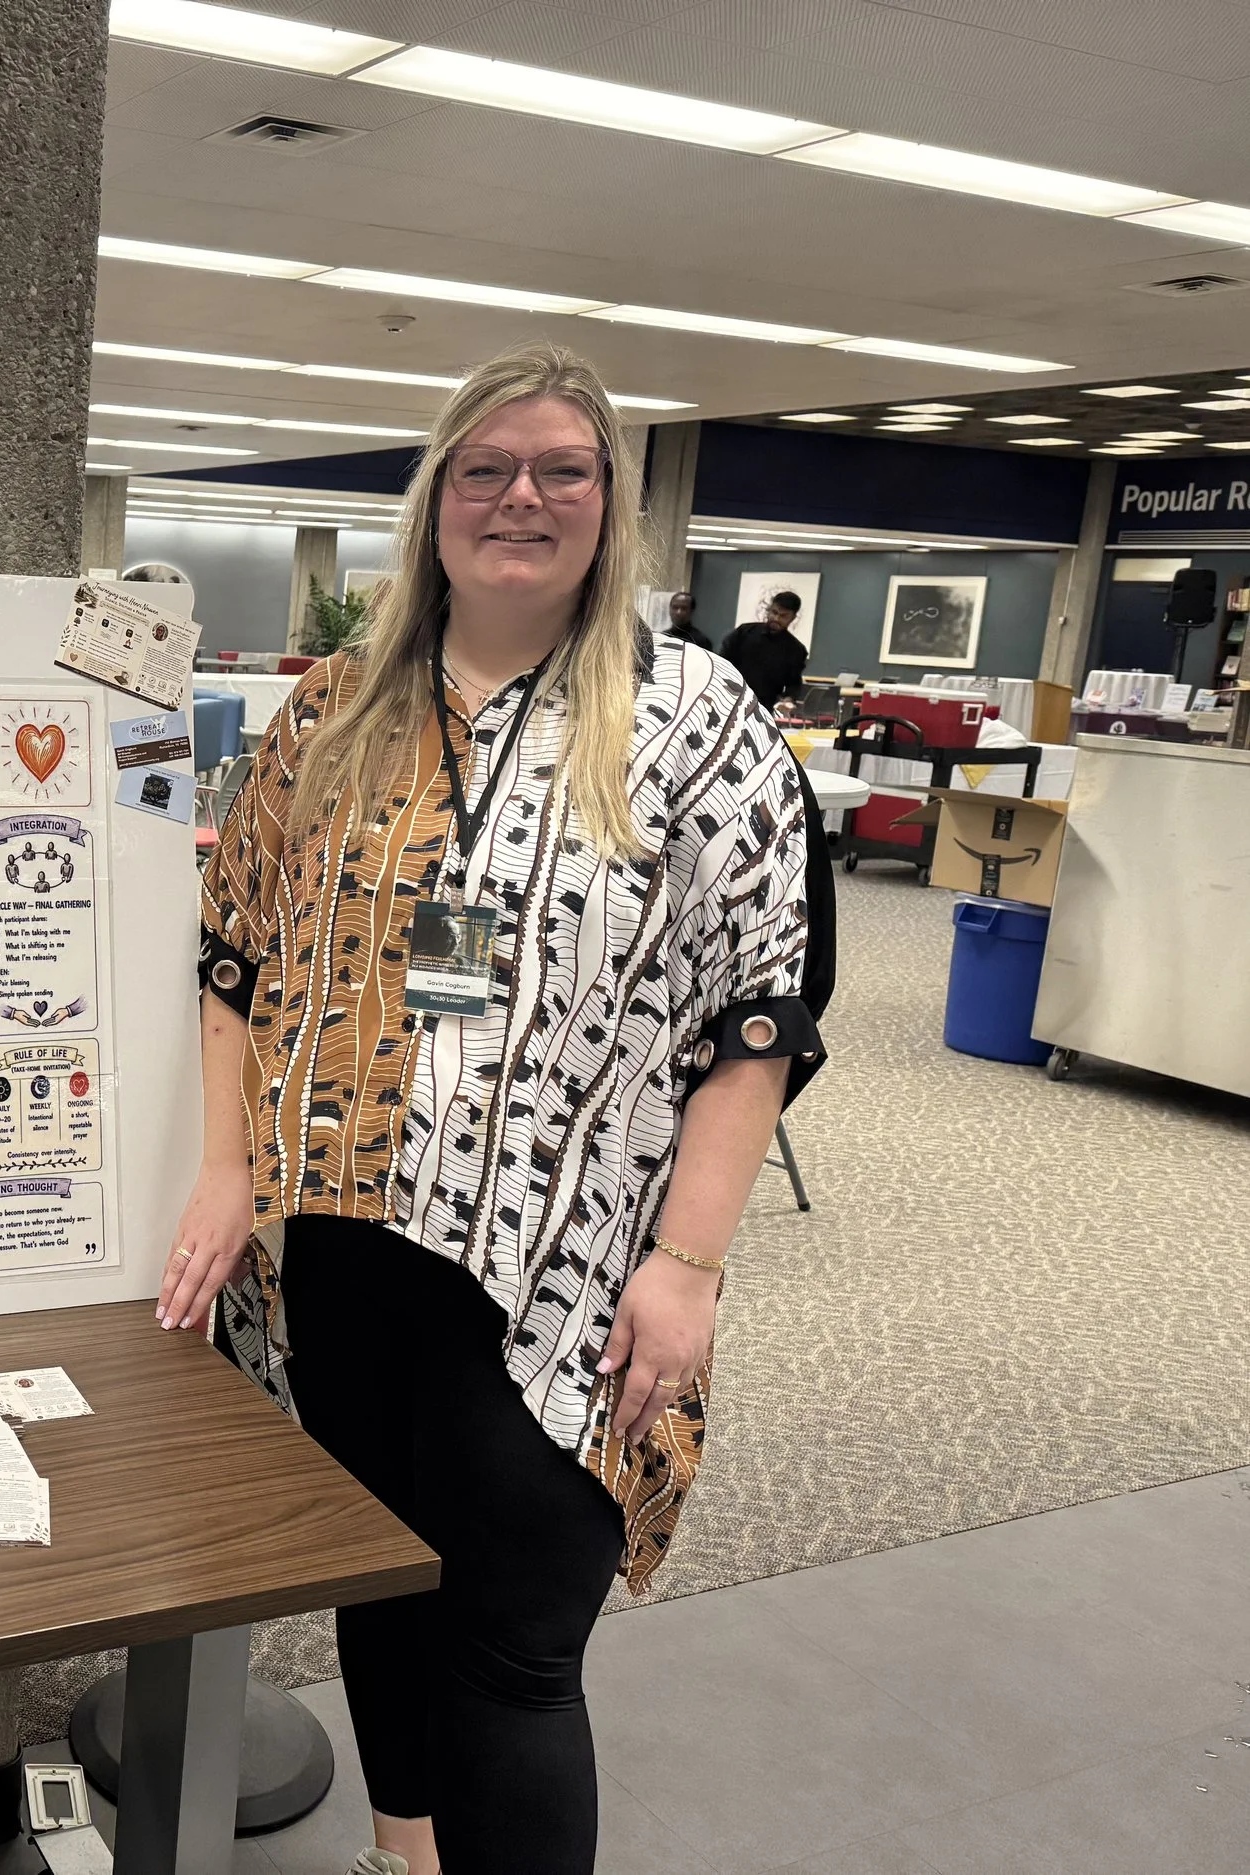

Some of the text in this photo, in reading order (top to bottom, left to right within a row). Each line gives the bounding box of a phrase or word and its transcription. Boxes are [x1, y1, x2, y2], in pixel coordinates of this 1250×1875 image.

[1121, 481, 1250, 518] Popular R
[10, 821, 67, 832] INTEGRATION
[13, 902, 27, 910] WAY
[35, 901, 53, 909] FINAL
[55, 900, 91, 908] GATHERING
[14, 1048, 68, 1060] RULE OF LIFE
[30, 1103, 51, 1111] WEEKLY
[67, 1100, 94, 1108] ONGOING
[18, 1182, 58, 1194] THOUGHT
